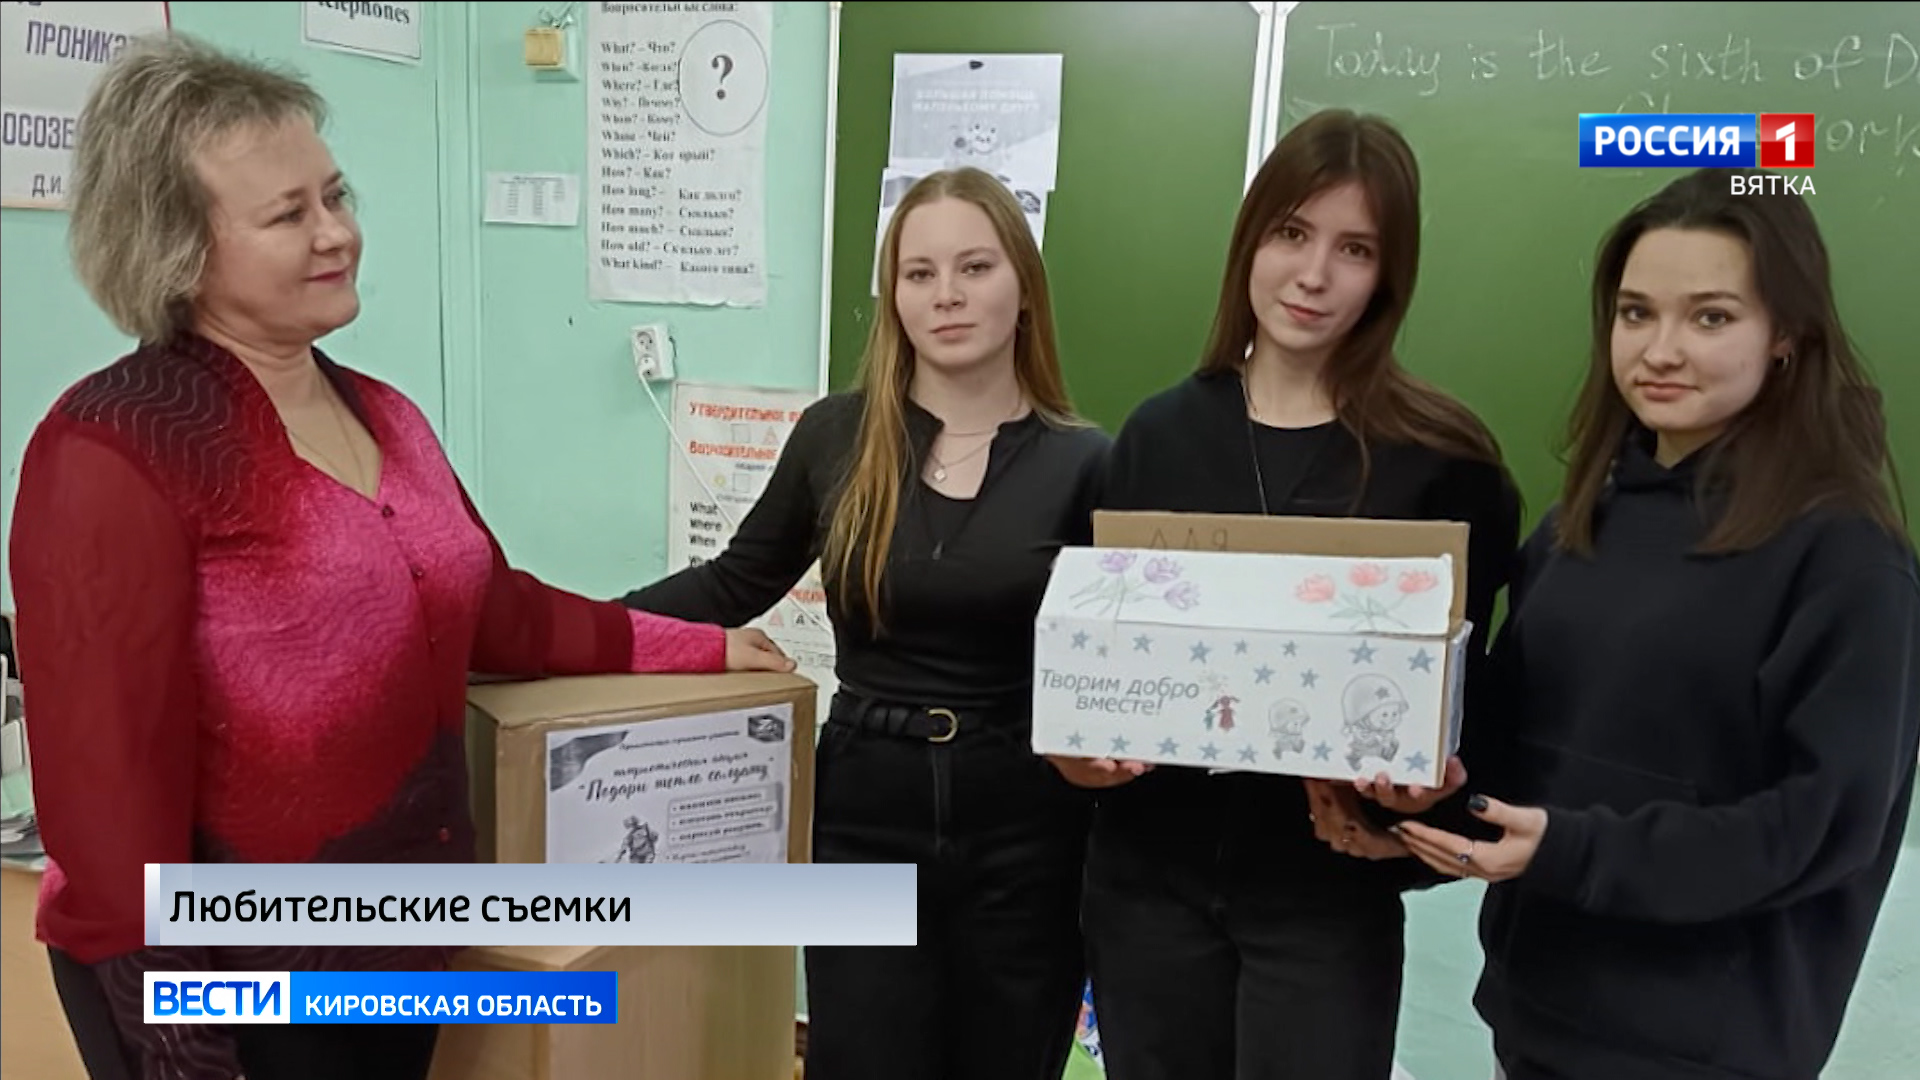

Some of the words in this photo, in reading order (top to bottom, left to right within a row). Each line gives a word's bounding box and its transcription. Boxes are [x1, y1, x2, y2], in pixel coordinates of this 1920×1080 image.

[319, 1, 410, 24] eephones
[1317, 22, 1441, 96] Today
[1467, 43, 1499, 79] is
[1529, 29, 1612, 80] the
[1650, 33, 1763, 85] sixth
[1794, 35, 1865, 89] of
[1884, 32, 1920, 90] D
[2, 111, 76, 150] ОСОЗЕ
[1814, 114, 1920, 160] ork
[601, 184, 625, 196] How
[601, 203, 625, 216] How
[601, 221, 624, 233] How
[601, 239, 624, 251] How
[1041, 669, 1120, 694] Творим
[1126, 677, 1200, 700] добро
[1075, 695, 1165, 716] вместе!
